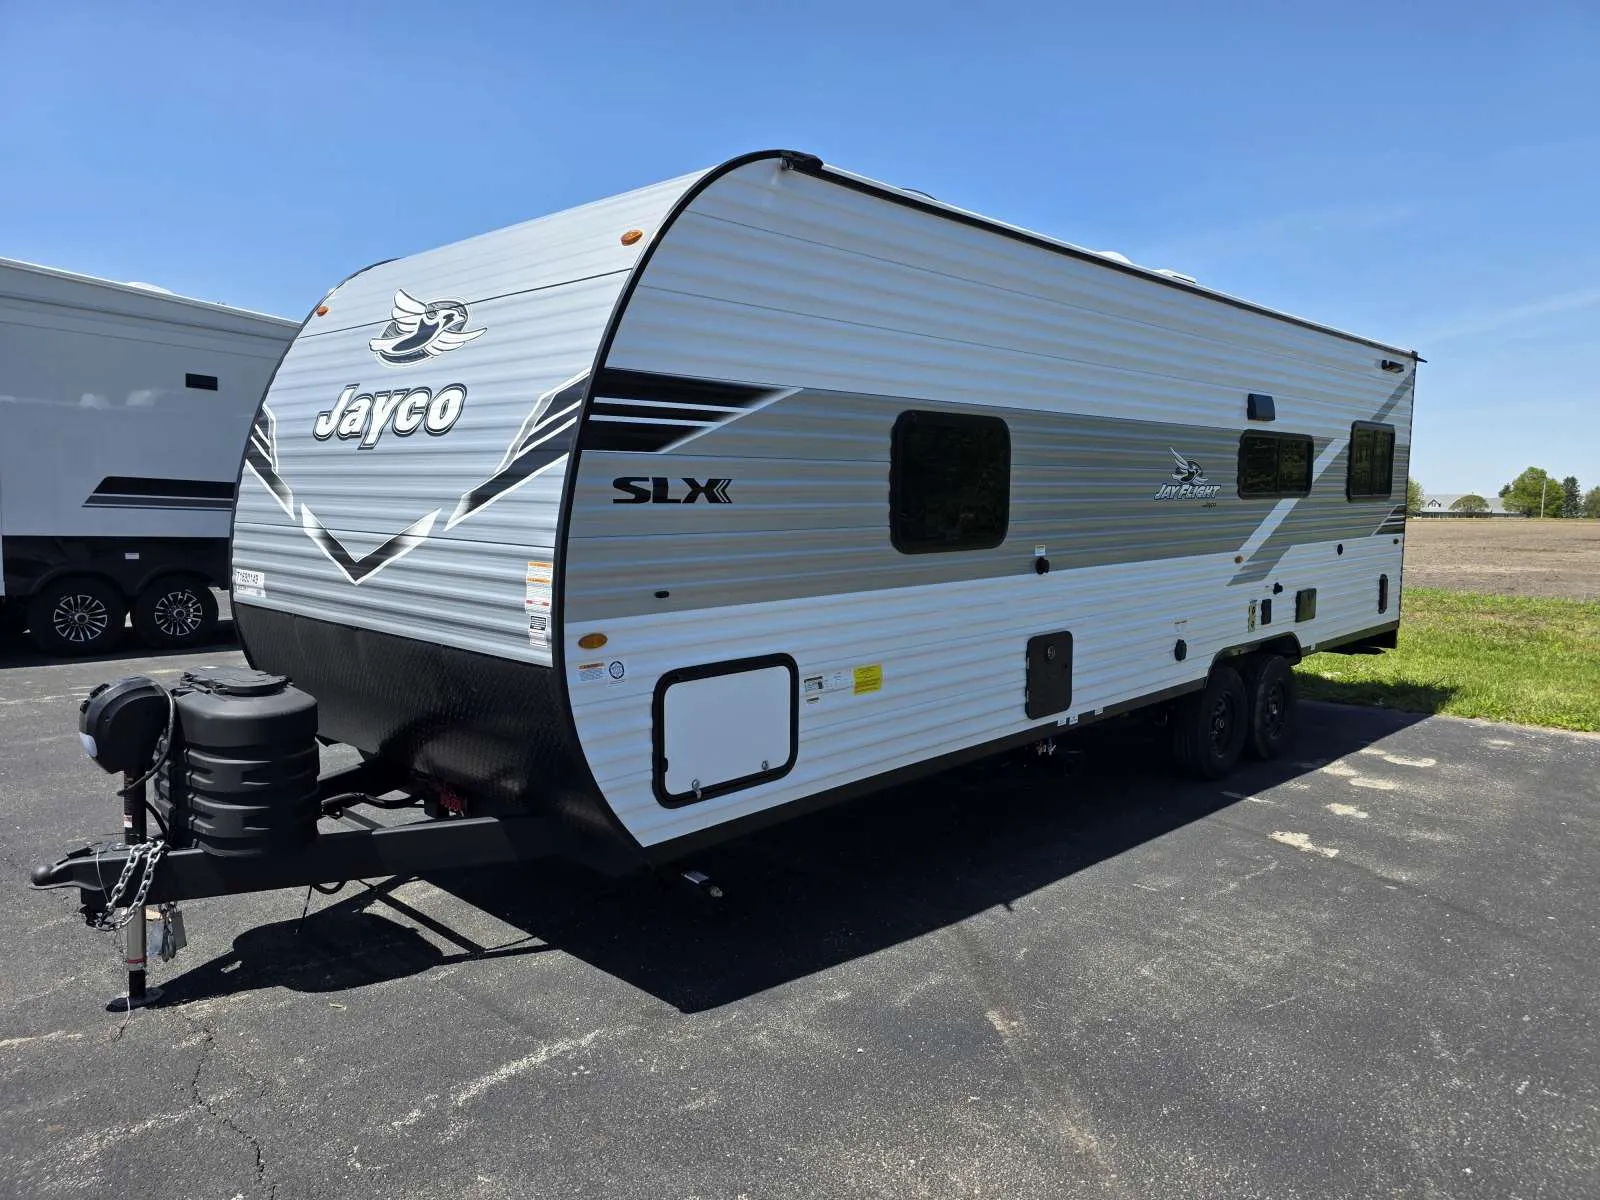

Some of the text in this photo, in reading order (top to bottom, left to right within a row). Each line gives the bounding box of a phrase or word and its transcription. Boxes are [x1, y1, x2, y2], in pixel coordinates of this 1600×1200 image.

[313, 383, 467, 450] Jayco
[613, 476, 733, 504] SLX
[1154, 483, 1221, 500] JAY FLIGHT
